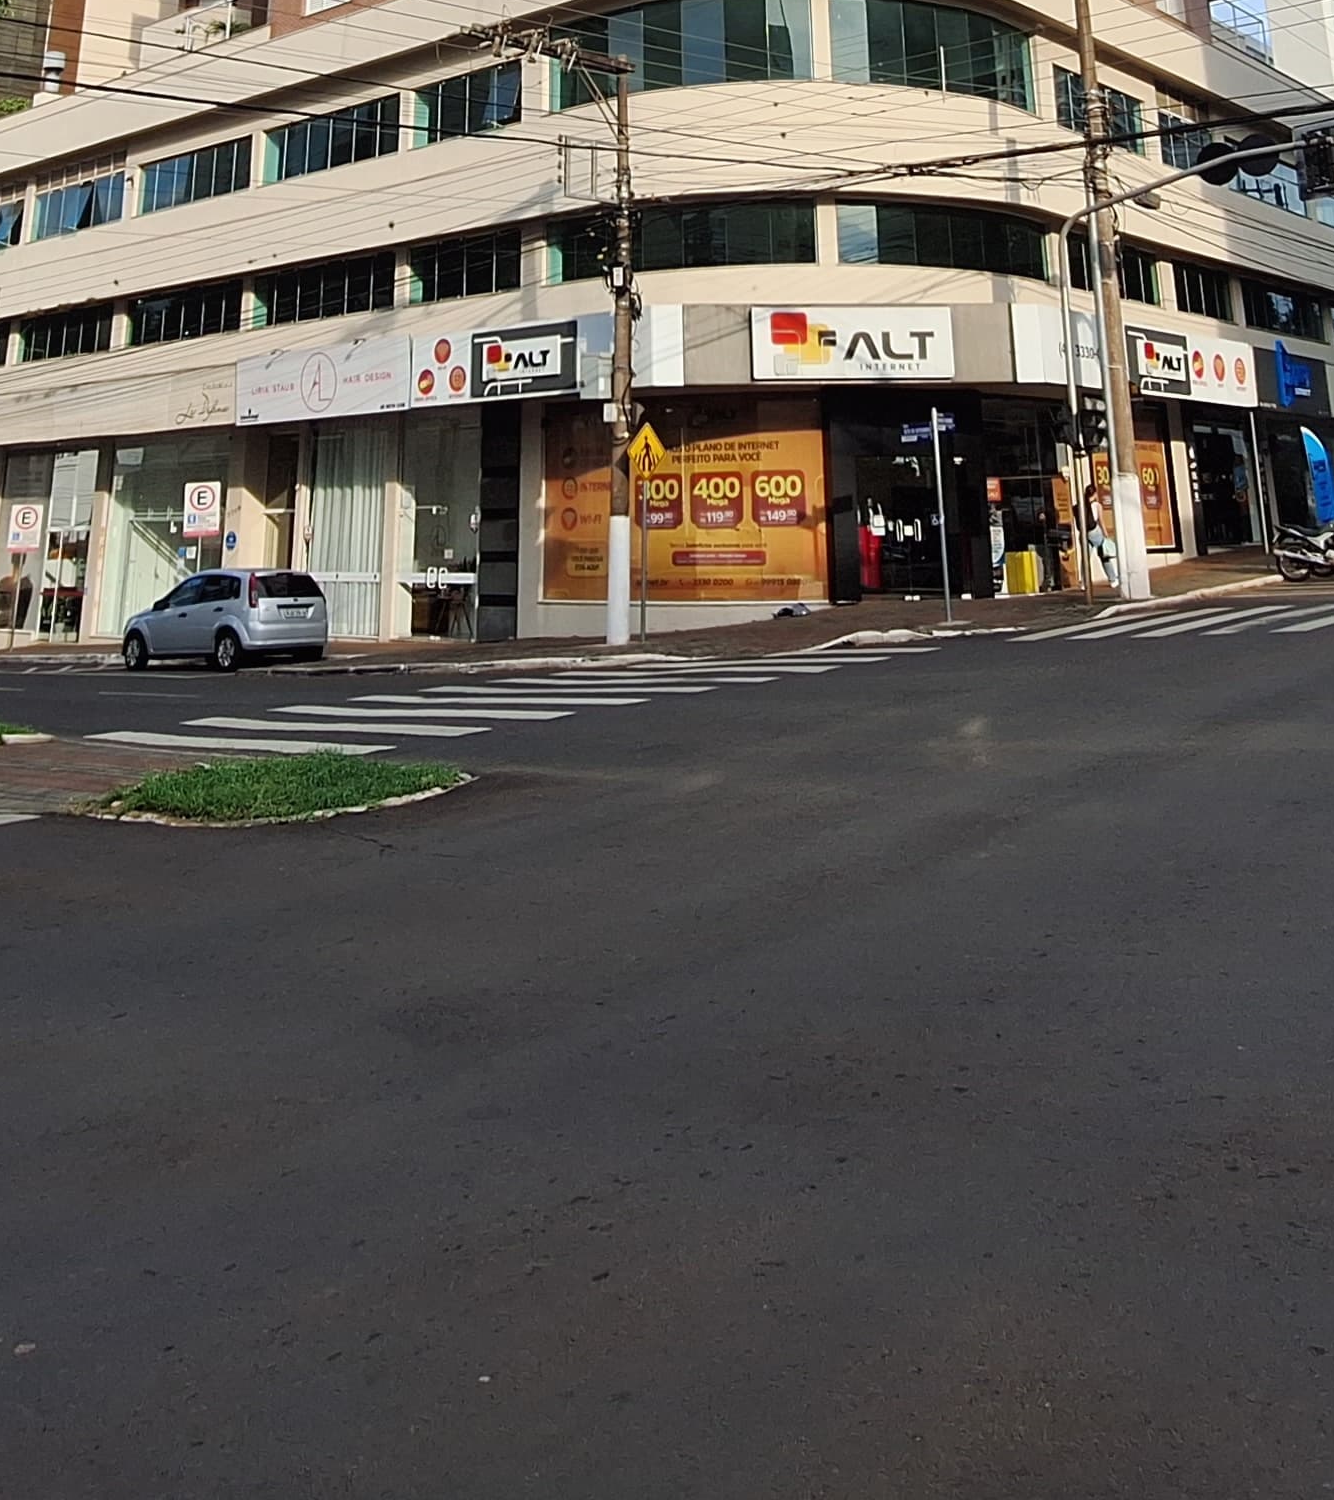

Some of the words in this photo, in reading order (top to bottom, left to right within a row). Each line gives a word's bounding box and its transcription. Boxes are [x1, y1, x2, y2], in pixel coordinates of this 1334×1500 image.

[859, 363, 921, 371] INTERNET
[343, 374, 361, 384] HAIR
[364, 371, 392, 382] DESIGN
[692, 442, 722, 452] PLANO
[724, 441, 735, 451] DE
[737, 440, 779, 451] INTERNET
[671, 453, 711, 464] PERFEITO
[713, 453, 736, 462] PARA
[579, 481, 612, 493] INTERN
[693, 476, 740, 499] 400
[755, 475, 802, 497] 600
[197, 490, 207, 506] E
[649, 499, 670, 508] Mega
[707, 498, 729, 507] Mega
[768, 496, 790, 505] Mega
[22, 511, 31, 525] E
